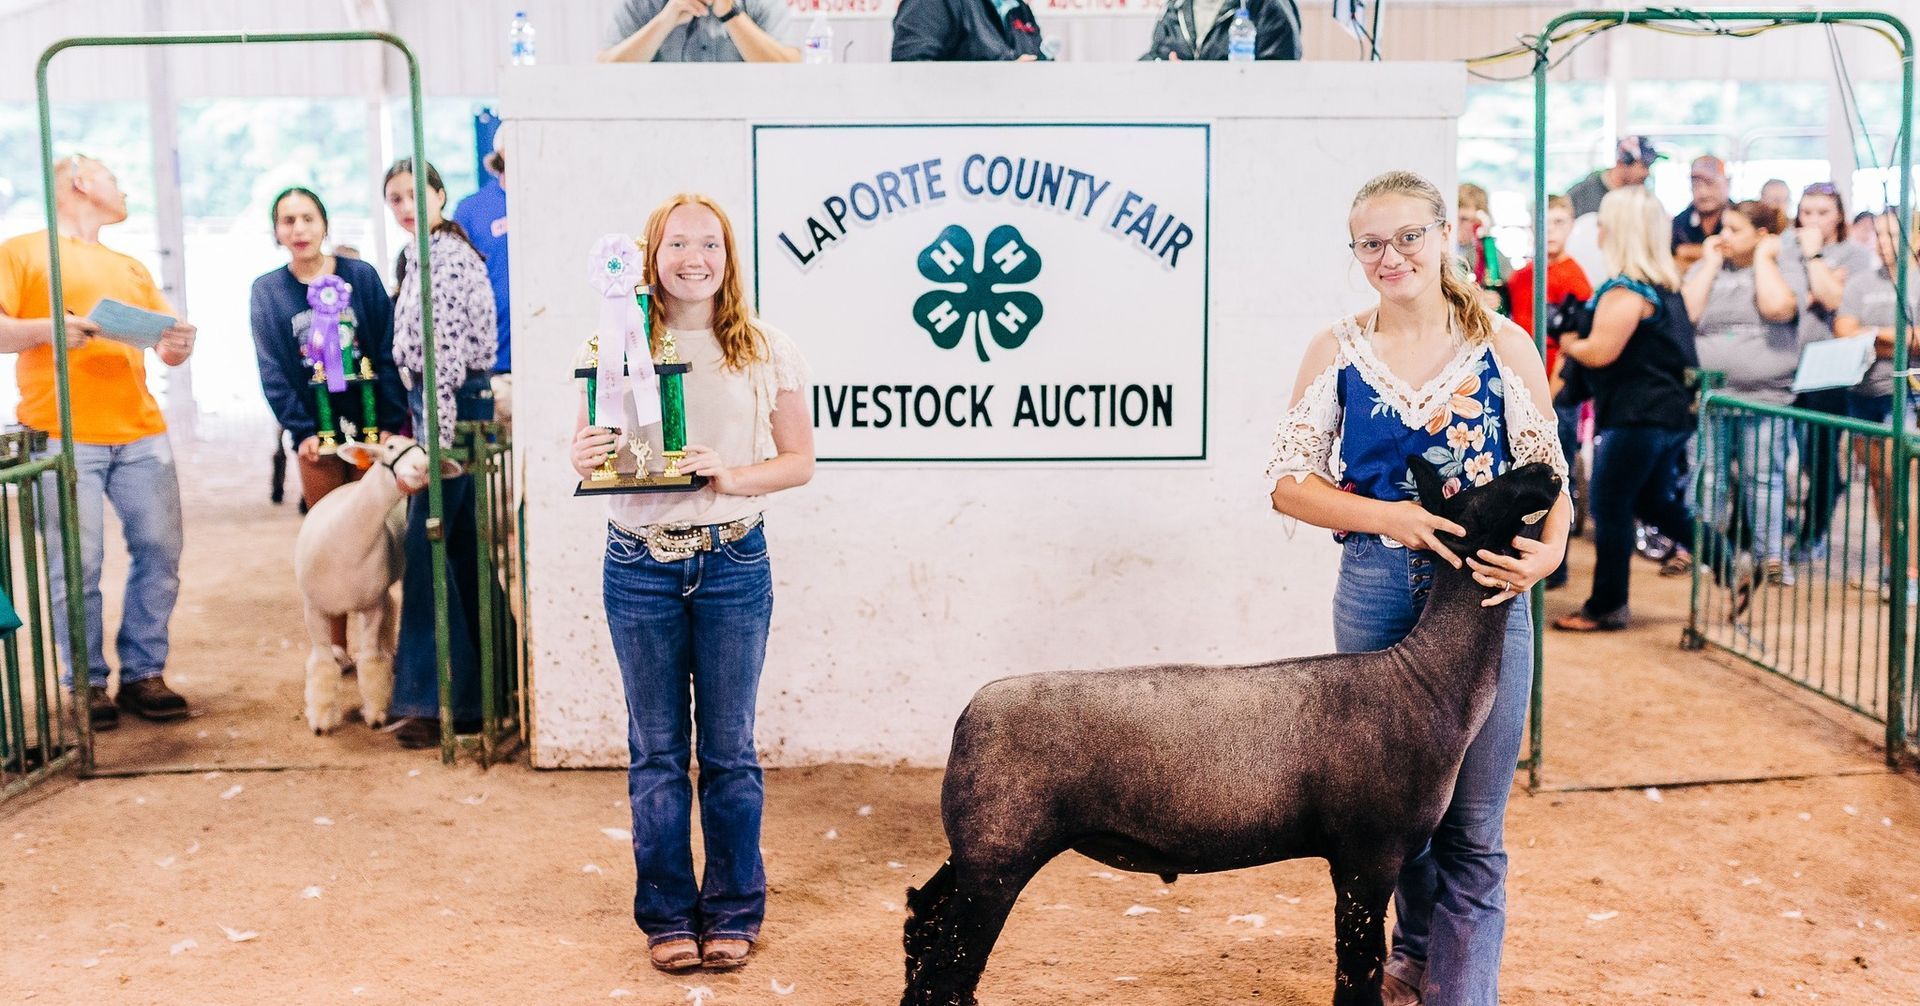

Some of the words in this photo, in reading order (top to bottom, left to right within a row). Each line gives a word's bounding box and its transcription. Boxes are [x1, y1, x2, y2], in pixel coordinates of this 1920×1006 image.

[779, 158, 947, 266] LAPORTE
[962, 153, 1111, 217] COUNTY
[1111, 190, 1194, 269] FAIR
[931, 240, 965, 275] H
[992, 240, 1027, 274] H
[927, 300, 960, 334] H
[995, 301, 1028, 334] H
[812, 384, 995, 429] IVESTOCK
[1012, 384, 1173, 428] AUCTION
